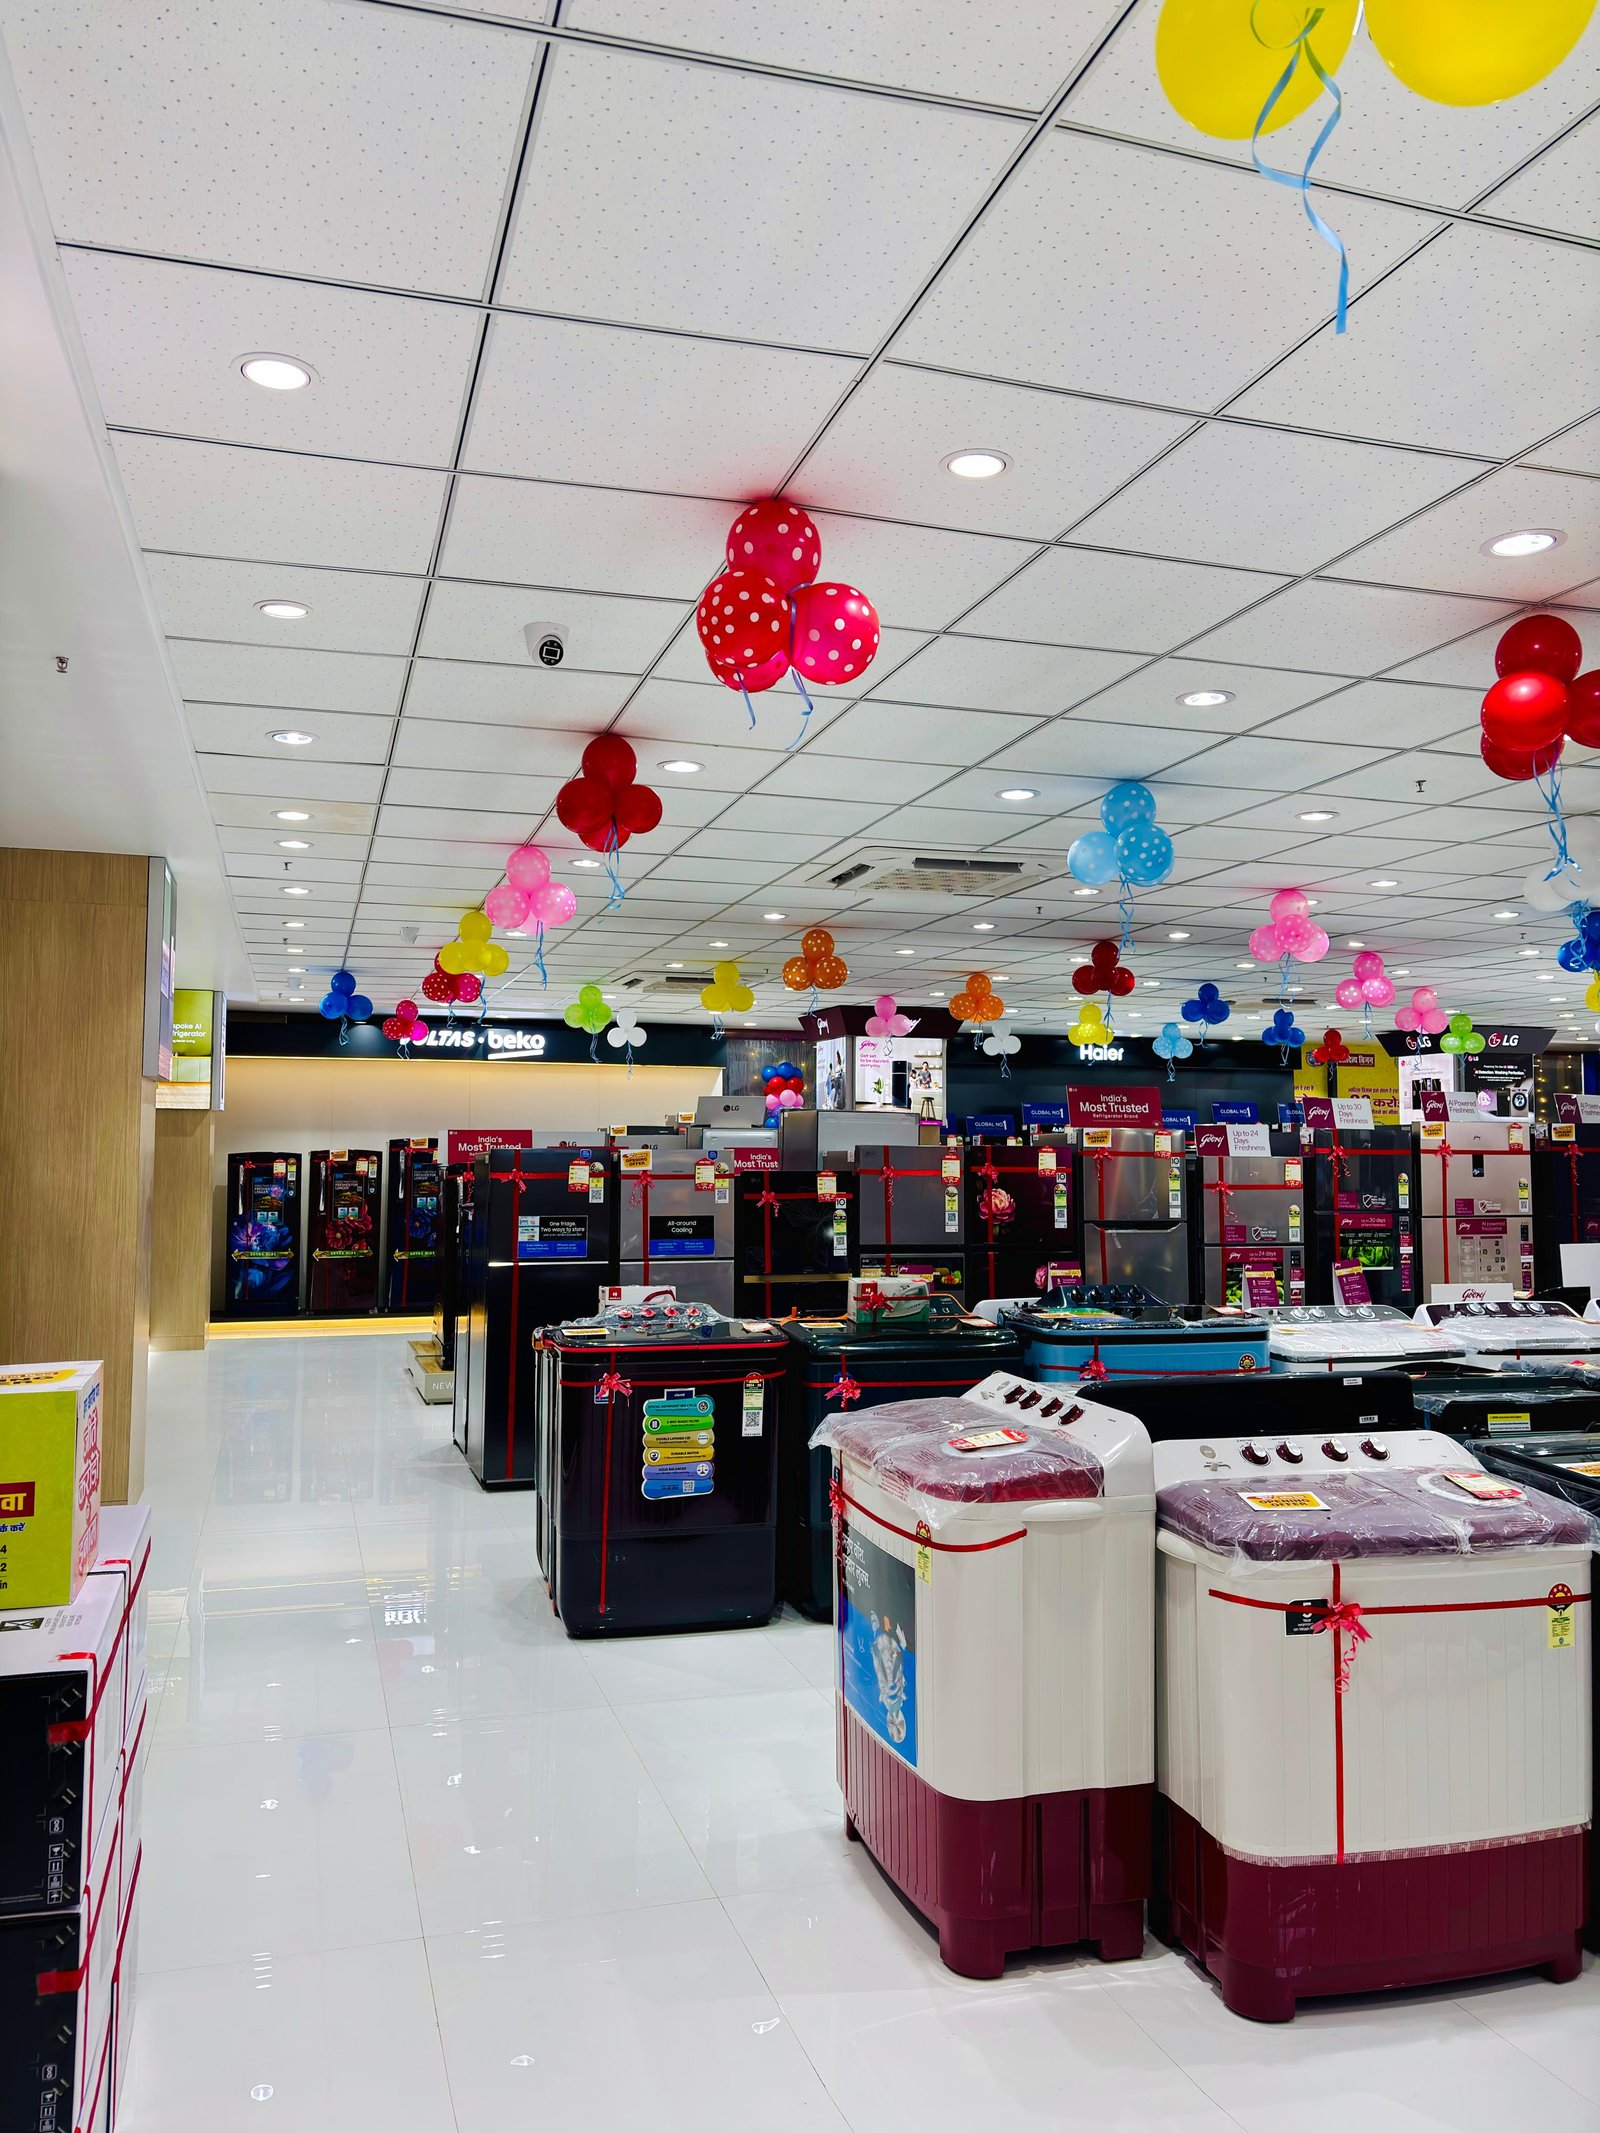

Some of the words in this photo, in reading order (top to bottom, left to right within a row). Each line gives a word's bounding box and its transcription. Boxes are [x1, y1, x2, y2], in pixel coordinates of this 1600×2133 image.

[400, 1030, 476, 1047] LTAS
[487, 1030, 546, 1050] beko
[1419, 1036, 1432, 1048] LG
[1502, 1034, 1520, 1047] LG
[1079, 1044, 1125, 1061] Haier
[1100, 1094, 1128, 1103] India's
[1080, 1101, 1107, 1113] Most
[1107, 1102, 1150, 1114] Trusted
[1337, 1103, 1347, 1111] Up
[1425, 1099, 1445, 1114] Godrej
[1307, 1106, 1331, 1121] Godrej
[1338, 1111, 1353, 1119] Days
[1339, 1117, 1369, 1125] Freshness
[1232, 1130, 1243, 1138] Up
[1250, 1129, 1259, 1137] 24
[477, 1135, 503, 1143] India's
[1199, 1133, 1225, 1149] Godrej
[1233, 1137, 1249, 1145] Days
[457, 1142, 483, 1152] Most
[485, 1142, 522, 1150] Trusted
[1234, 1144, 1266, 1152] Freshness
[750, 1153, 772, 1161] India's
[733, 1159, 756, 1168] Most
[671, 1226, 693, 1235] Cooling
[1461, 1288, 1487, 1301] Godrej
[432, 1382, 454, 1390] NEW
